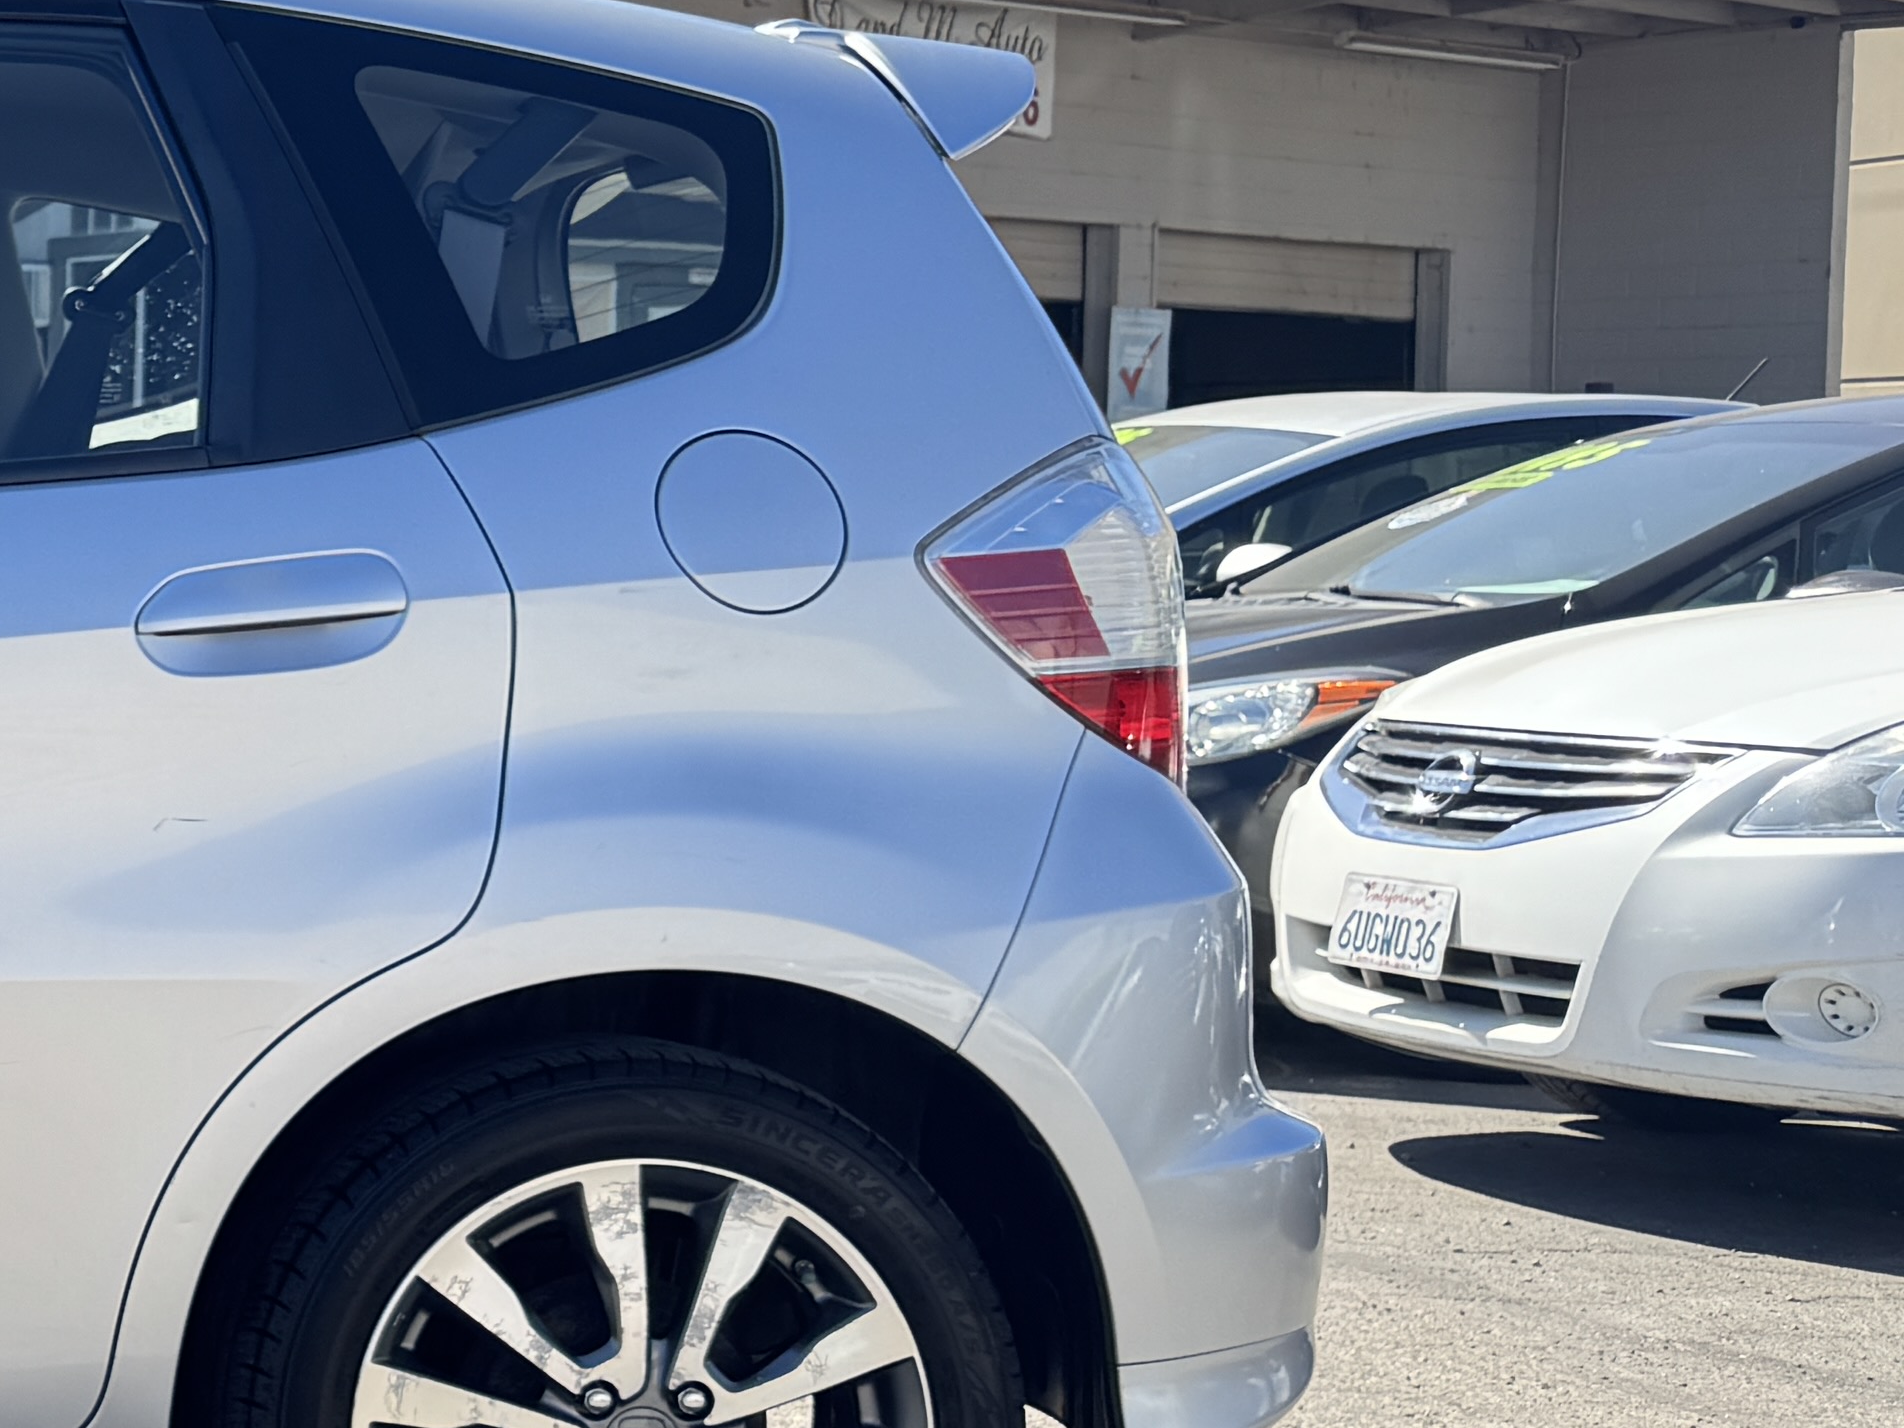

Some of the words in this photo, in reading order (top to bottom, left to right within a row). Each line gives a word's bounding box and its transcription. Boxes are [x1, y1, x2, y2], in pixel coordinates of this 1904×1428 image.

[855, 0, 908, 37] and
[917, 1, 957, 41] M
[975, 7, 1048, 64] Auto
[1365, 881, 1427, 910] California
[1338, 909, 1442, 963] 6UGW036
